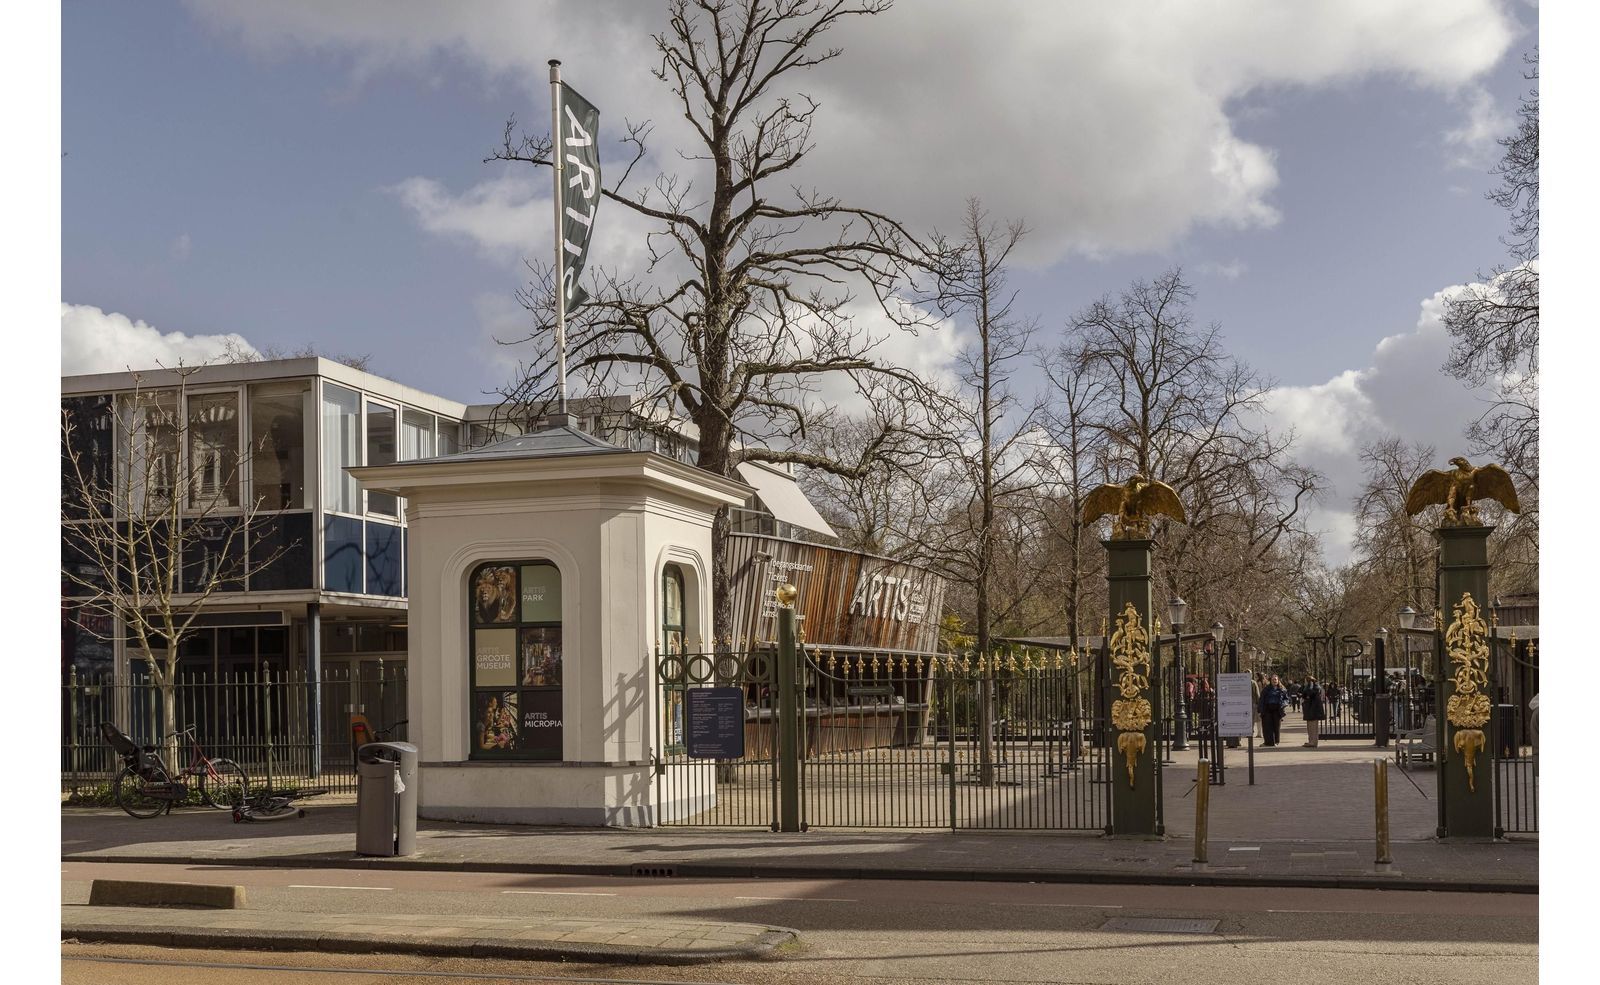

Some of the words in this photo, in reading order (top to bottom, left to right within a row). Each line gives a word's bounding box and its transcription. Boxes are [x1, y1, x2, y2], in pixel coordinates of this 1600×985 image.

[522, 594, 544, 602] PARK
[849, 570, 911, 621] ARTIS
[476, 654, 511, 662] GROOTE
[476, 662, 511, 670] MUSEUM
[524, 712, 548, 720] ARTIS
[524, 720, 563, 728] MICROPIA
